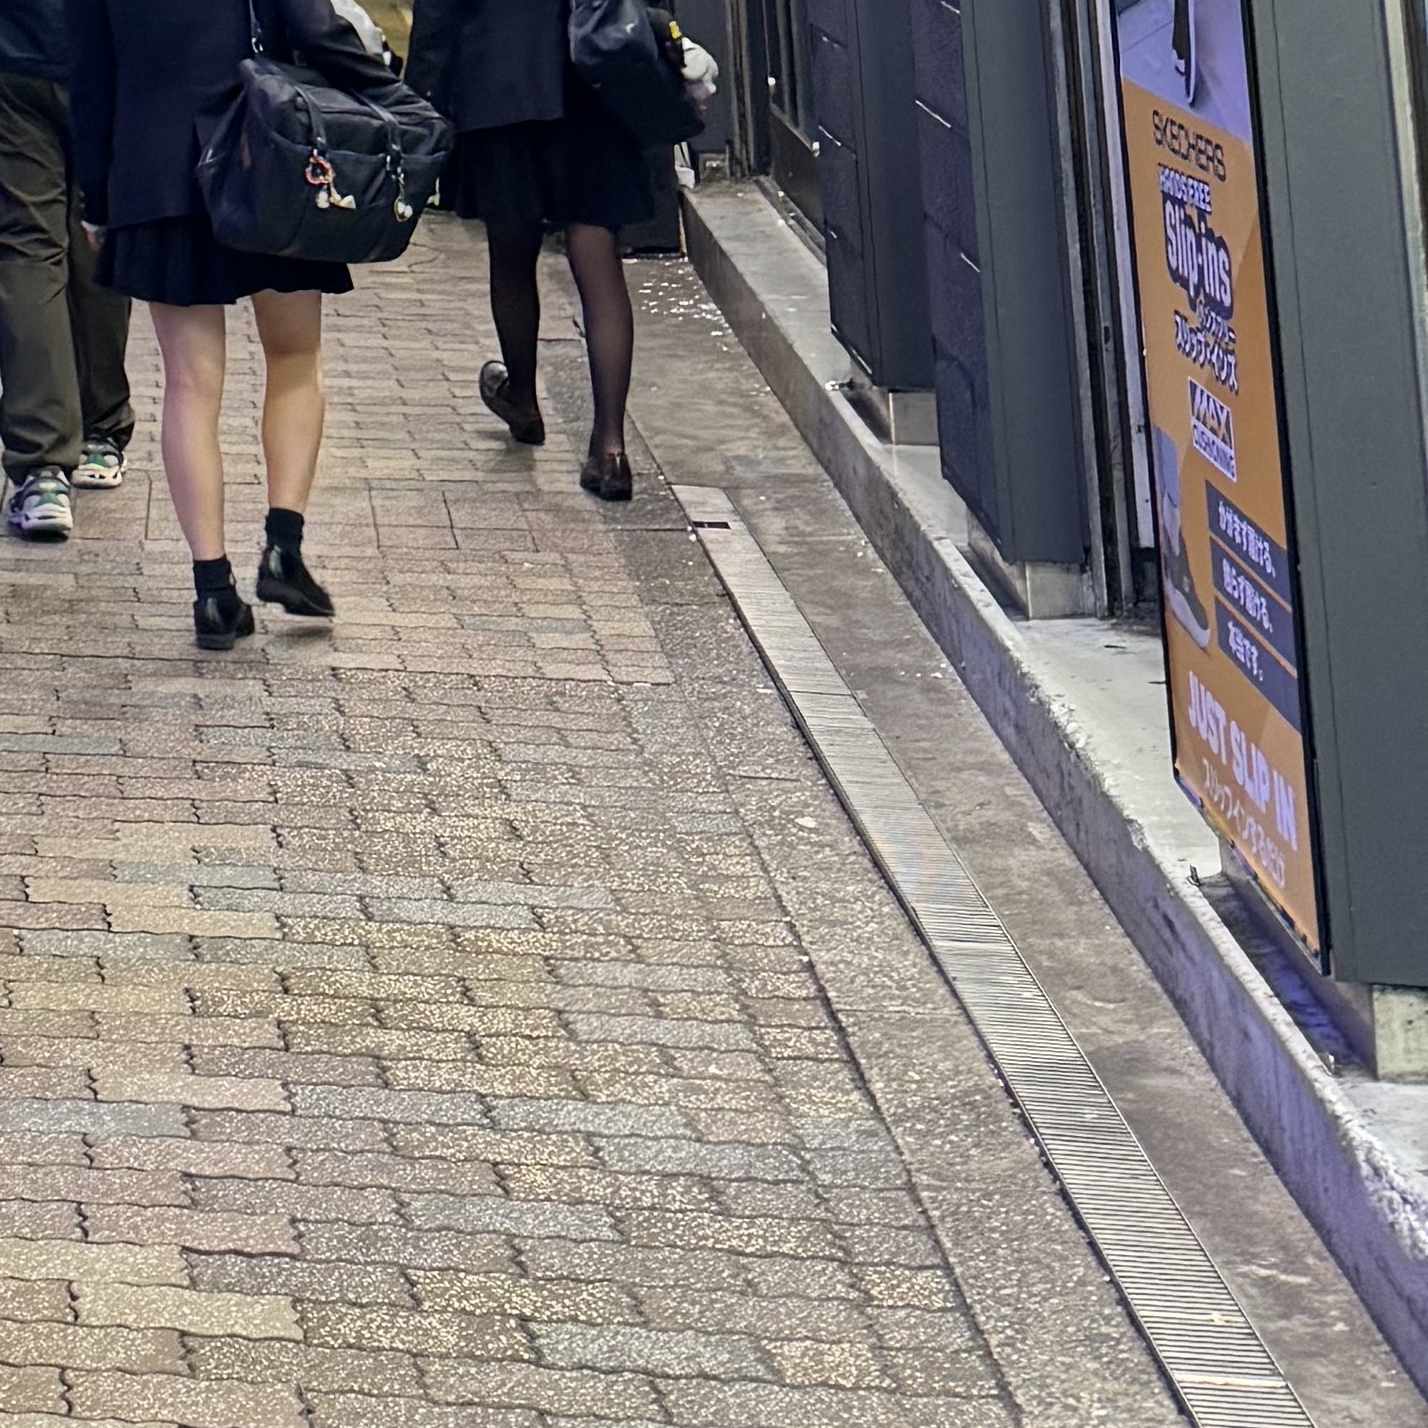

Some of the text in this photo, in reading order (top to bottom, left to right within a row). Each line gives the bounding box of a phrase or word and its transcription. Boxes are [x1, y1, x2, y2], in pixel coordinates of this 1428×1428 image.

[1152, 109, 1227, 183] SKECHERS
[1165, 199, 1232, 308] Slip-ins
[1190, 383, 1231, 449] MAX
[1187, 670, 1298, 851] JUST SLIP IN
